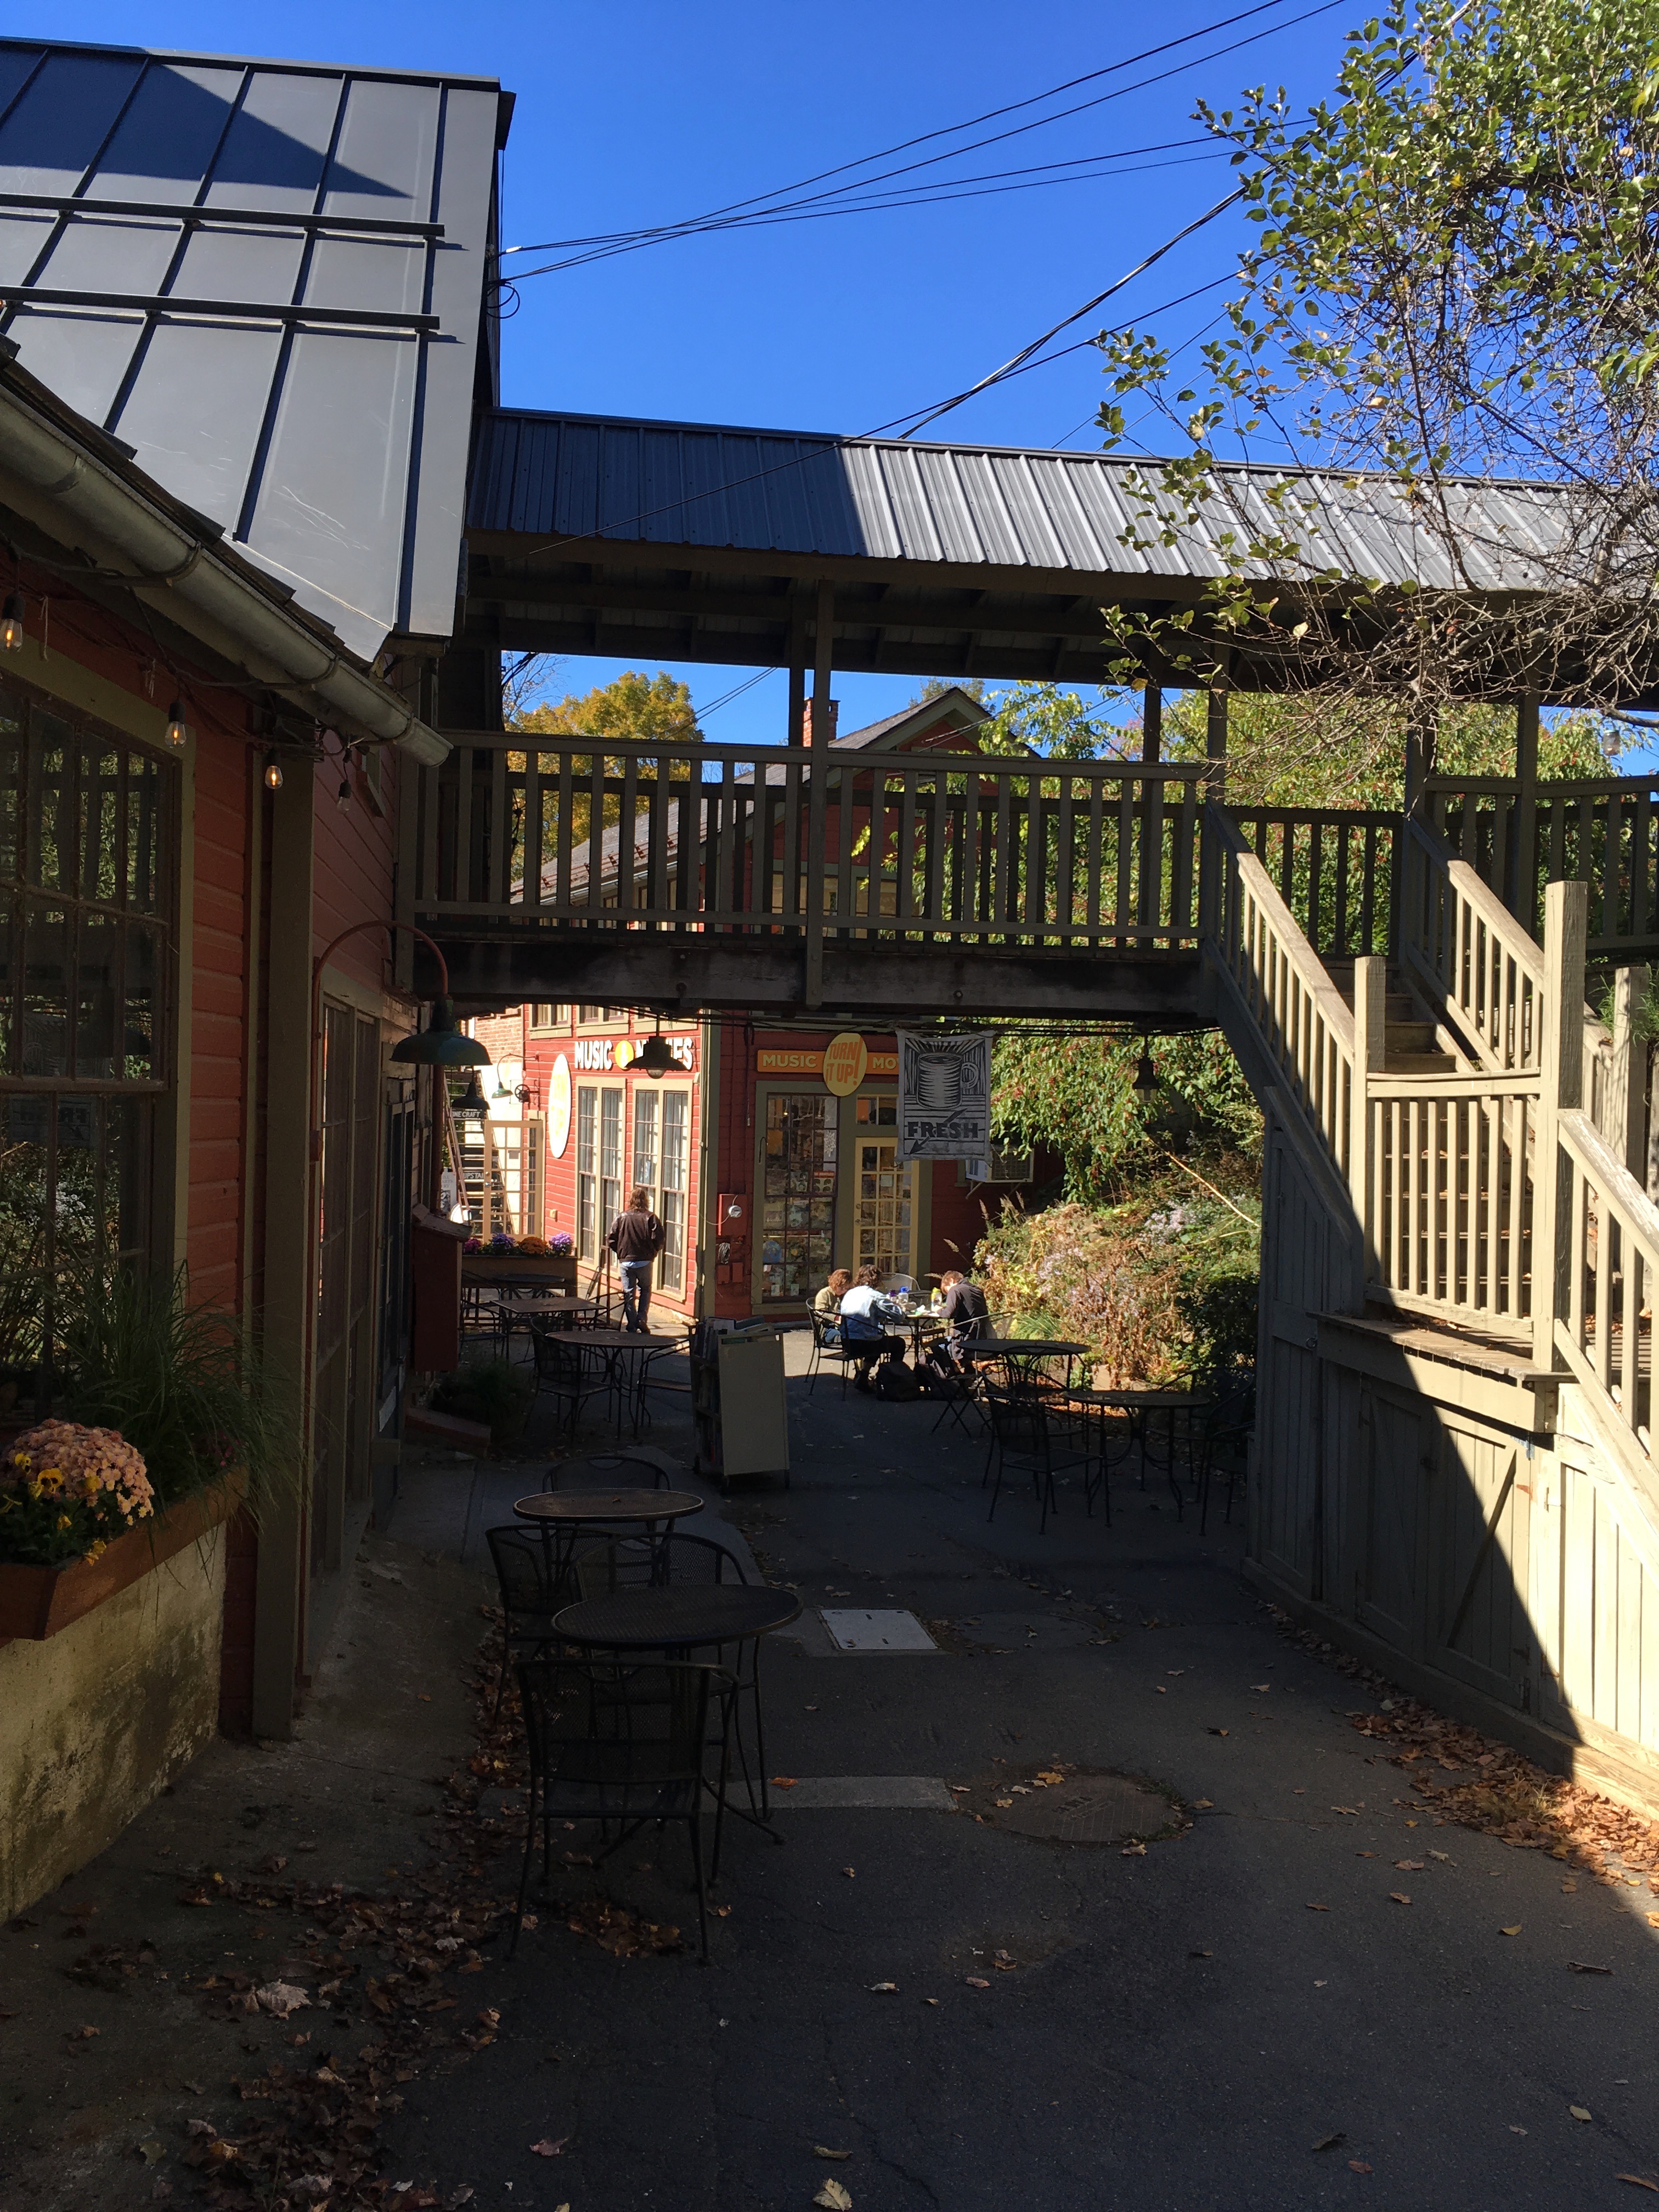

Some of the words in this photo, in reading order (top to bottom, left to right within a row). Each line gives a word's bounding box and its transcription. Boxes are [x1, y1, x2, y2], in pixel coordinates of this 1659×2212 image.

[574, 1040, 613, 1070] MUSIC
[828, 1041, 859, 1060] TURN
[762, 1054, 817, 1068] MUSIC
[872, 1057, 899, 1070] MO
[907, 1121, 979, 1139] FRESH
